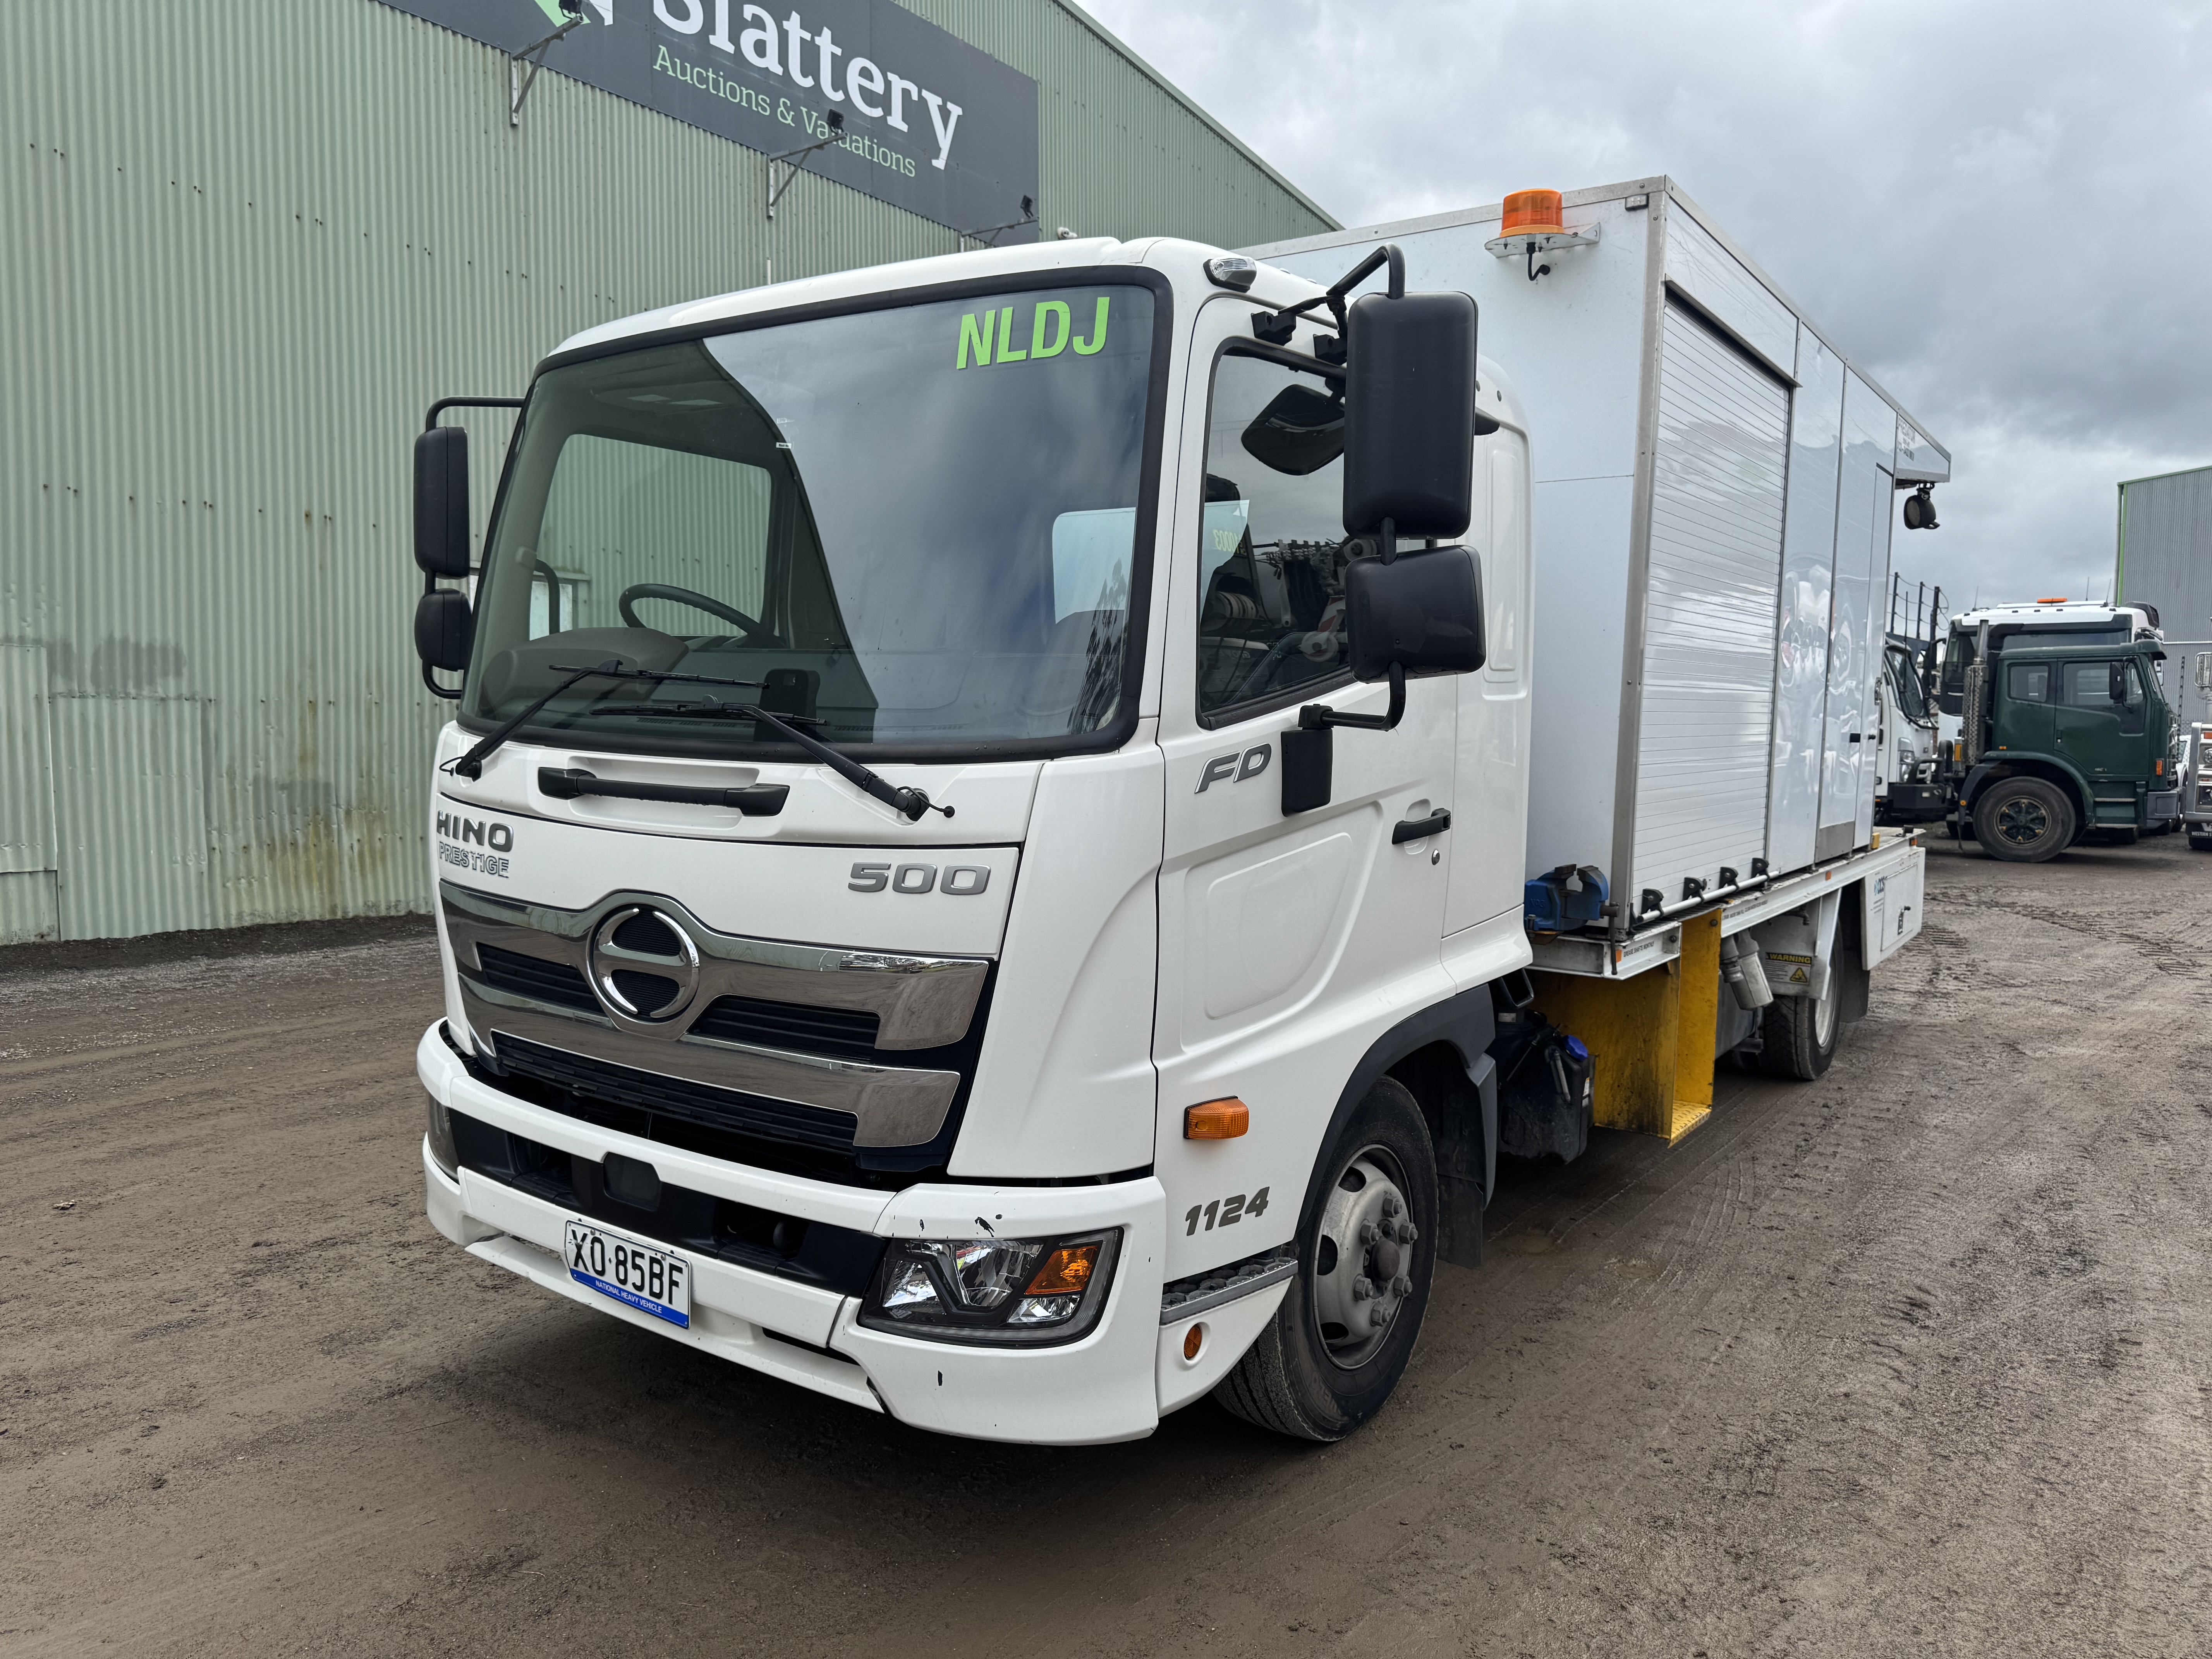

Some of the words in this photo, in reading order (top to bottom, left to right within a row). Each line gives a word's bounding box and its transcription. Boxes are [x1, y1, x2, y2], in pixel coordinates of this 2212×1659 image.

[653, 45, 770, 116] Auctions
[777, 98, 795, 127] &
[800, 106, 915, 177] Vauations
[957, 297, 1109, 369] NLDJ
[1194, 743, 1272, 794] FD
[436, 810, 514, 852] HINO
[439, 841, 509, 878] PRESTIGE
[848, 862, 991, 896] 500
[1770, 953, 1811, 964] WARNING
[1185, 1186, 1270, 1236] 1124
[595, 1280, 620, 1297] NATIONAL
[621, 1290, 639, 1304] HEAVY
[640, 1299, 662, 1314] VEHICLE
